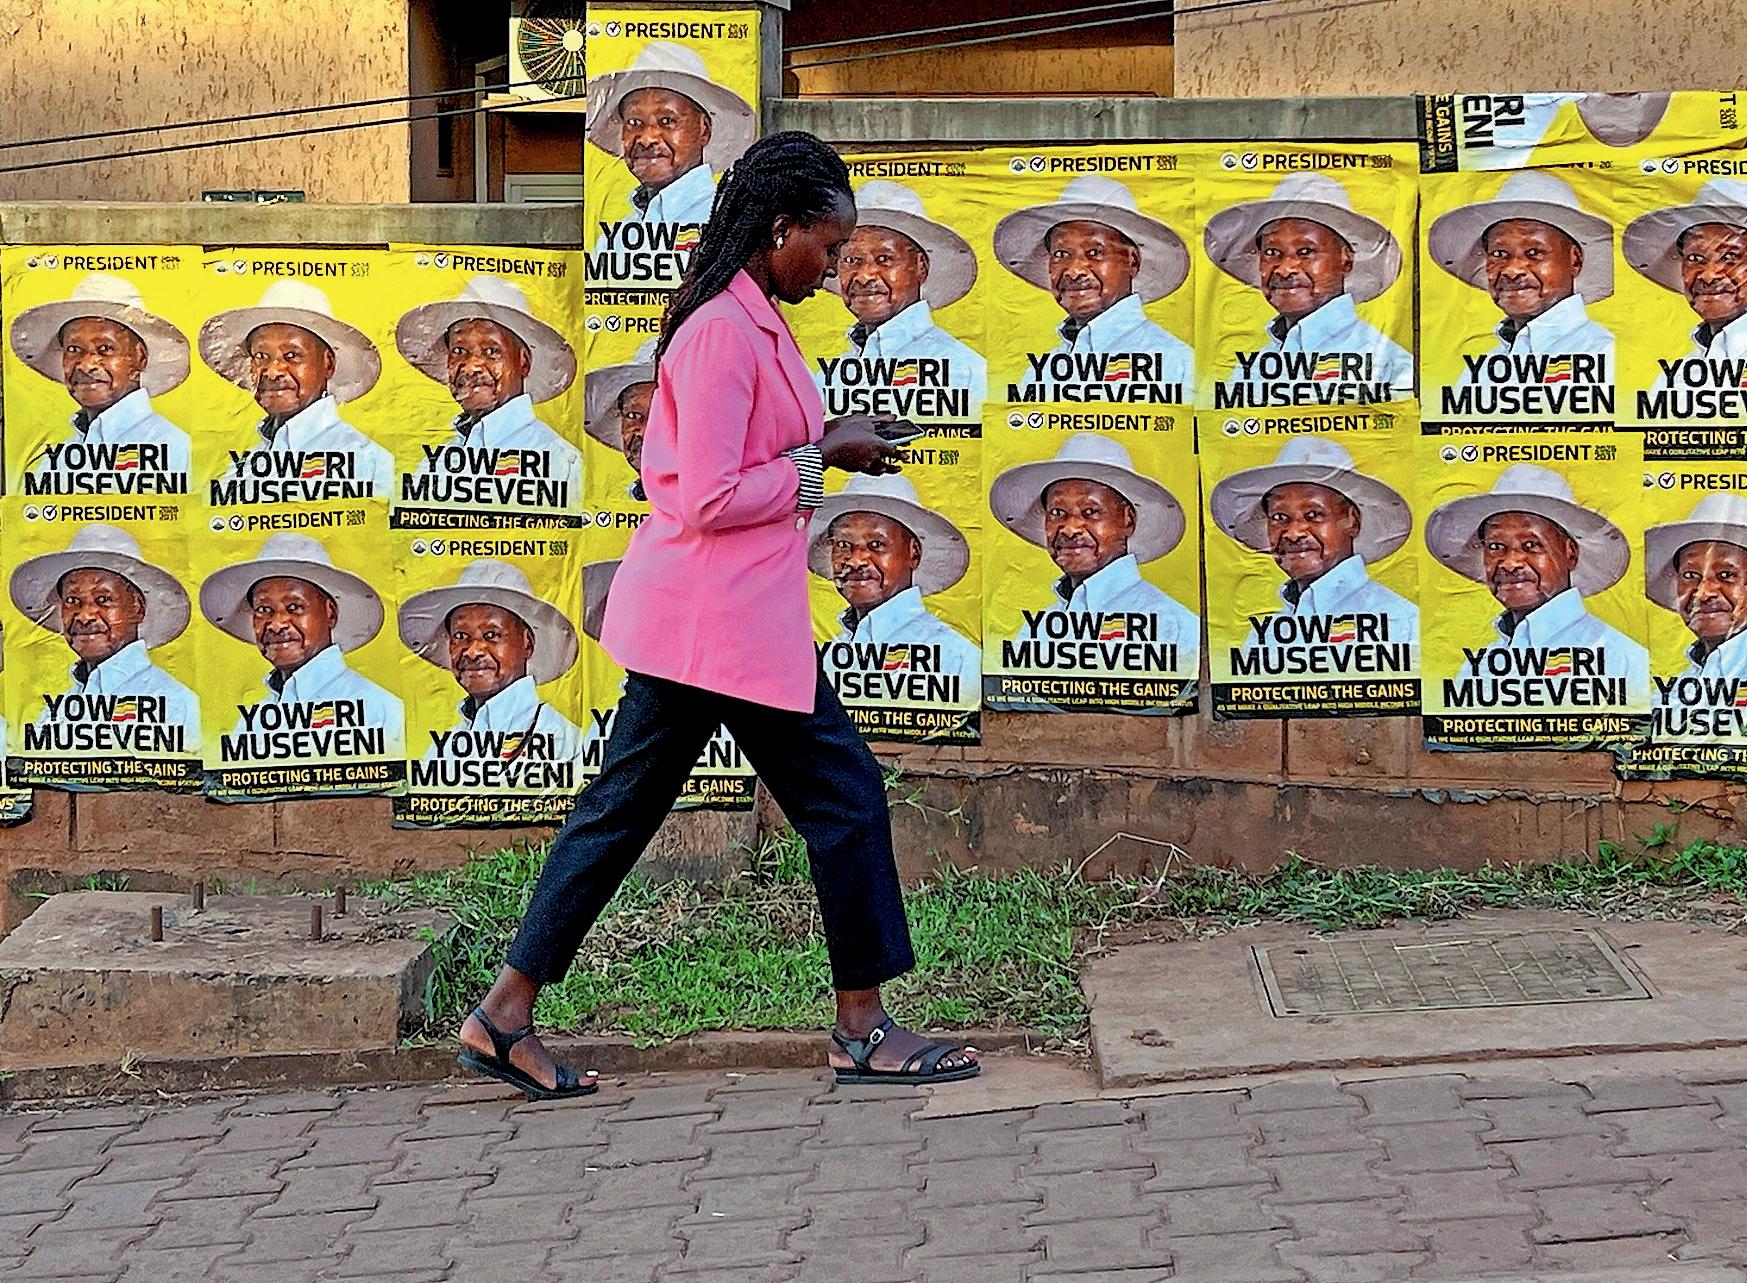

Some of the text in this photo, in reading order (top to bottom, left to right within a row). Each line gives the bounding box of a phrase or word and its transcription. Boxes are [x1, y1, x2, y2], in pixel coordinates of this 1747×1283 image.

[625, 22, 726, 39] PRESIDENT
[1436, 106, 1452, 153] GAINS
[1050, 155, 1155, 173] PRESIDENT
[1262, 153, 1369, 170] PRESIDENT
[599, 221, 708, 251] YOWE
[63, 256, 156, 271] PRESIDENT
[252, 261, 348, 277] PRESIDENT
[452, 254, 545, 277] PRESIDENT
[817, 357, 950, 387] YOWERI
[1026, 352, 1163, 382] YOWERI
[1235, 351, 1373, 382] YOWERI
[1462, 353, 1606, 384] YOWERI
[823, 387, 969, 417] USEVENI
[1007, 382, 1183, 404] MUSEVENI
[1214, 381, 1392, 410] MUSEVENI
[1441, 384, 1615, 415] MUSEVEN
[1048, 413, 1151, 432] PRESIDENT
[1264, 414, 1370, 435] PRESIDENT
[46, 443, 169, 471] YOWERI
[228, 450, 355, 479] YOWERI
[421, 443, 551, 478] YOWERI
[1483, 444, 1592, 462] PRESIDENT
[24, 471, 188, 496] MUSEVENI
[209, 479, 374, 508] MUSEVENI
[402, 472, 569, 508] MUSEVENI
[61, 505, 158, 522] PRESIDENT
[247, 510, 345, 532] PRESIDENT
[399, 510, 489, 528] PROTECTING
[492, 514, 524, 529] THE
[449, 540, 547, 557] PRESIDENT
[1021, 609, 1158, 642] YOWERI
[1248, 612, 1389, 646] YOWERI
[1002, 640, 1178, 673] MUSEVENI
[1230, 642, 1411, 676] MUSEVENI
[1462, 646, 1606, 677] YOWERI
[1001, 678, 1180, 698] PROTECTING THE GAINS
[1231, 682, 1415, 702] PROTECTING THE GAINS
[1442, 677, 1628, 708] MUSEVENI
[43, 694, 166, 724] YOWERI
[237, 698, 365, 732] YOWERI
[885, 711, 913, 726] THE
[916, 712, 961, 729] GAINS
[24, 723, 185, 752] MUSEVENI
[1443, 717, 1631, 733] PROTECTING THE GAINS
[220, 726, 386, 762] MUSEVENI
[429, 730, 555, 761] YOWERI
[1632, 747, 1728, 761] PROTECTING
[23, 760, 187, 777] PROTECTING THE GAINS
[222, 765, 389, 786] PROTECTING THE GAINS
[410, 759, 574, 789] MUSEVENI
[699, 779, 744, 794] GAINS
[410, 796, 576, 813] PROTECTING THE GAINS
